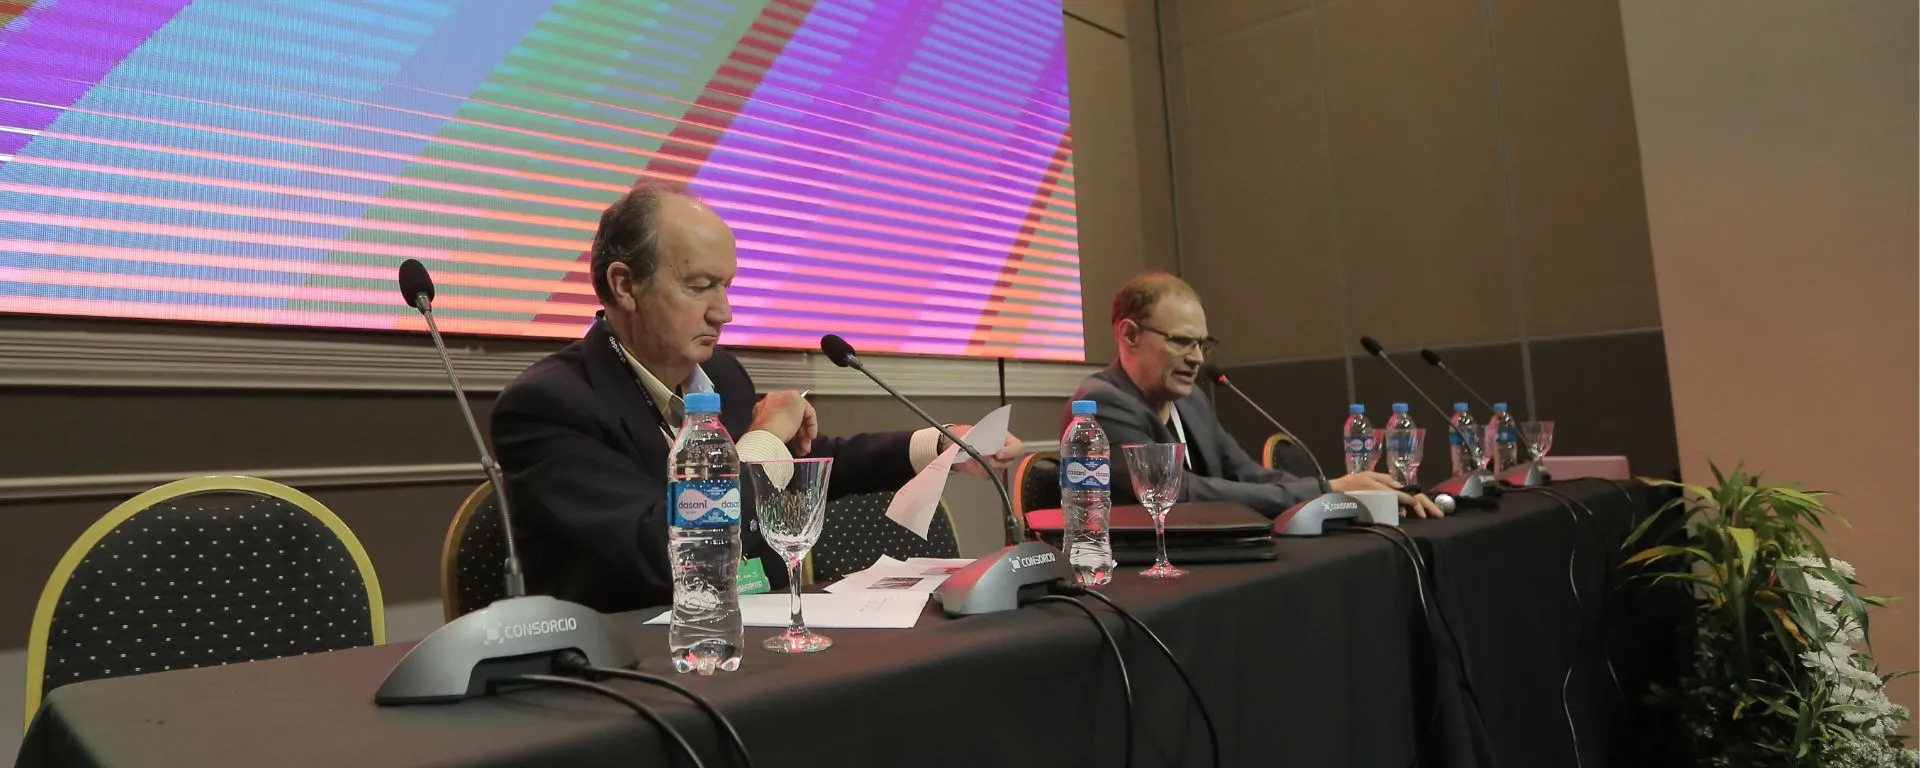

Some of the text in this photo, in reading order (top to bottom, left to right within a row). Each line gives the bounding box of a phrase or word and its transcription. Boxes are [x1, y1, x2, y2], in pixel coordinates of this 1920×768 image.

[679, 500, 707, 509] dasani
[1021, 552, 1056, 567] CONSORCIO
[504, 617, 577, 639] CONSORCIO
